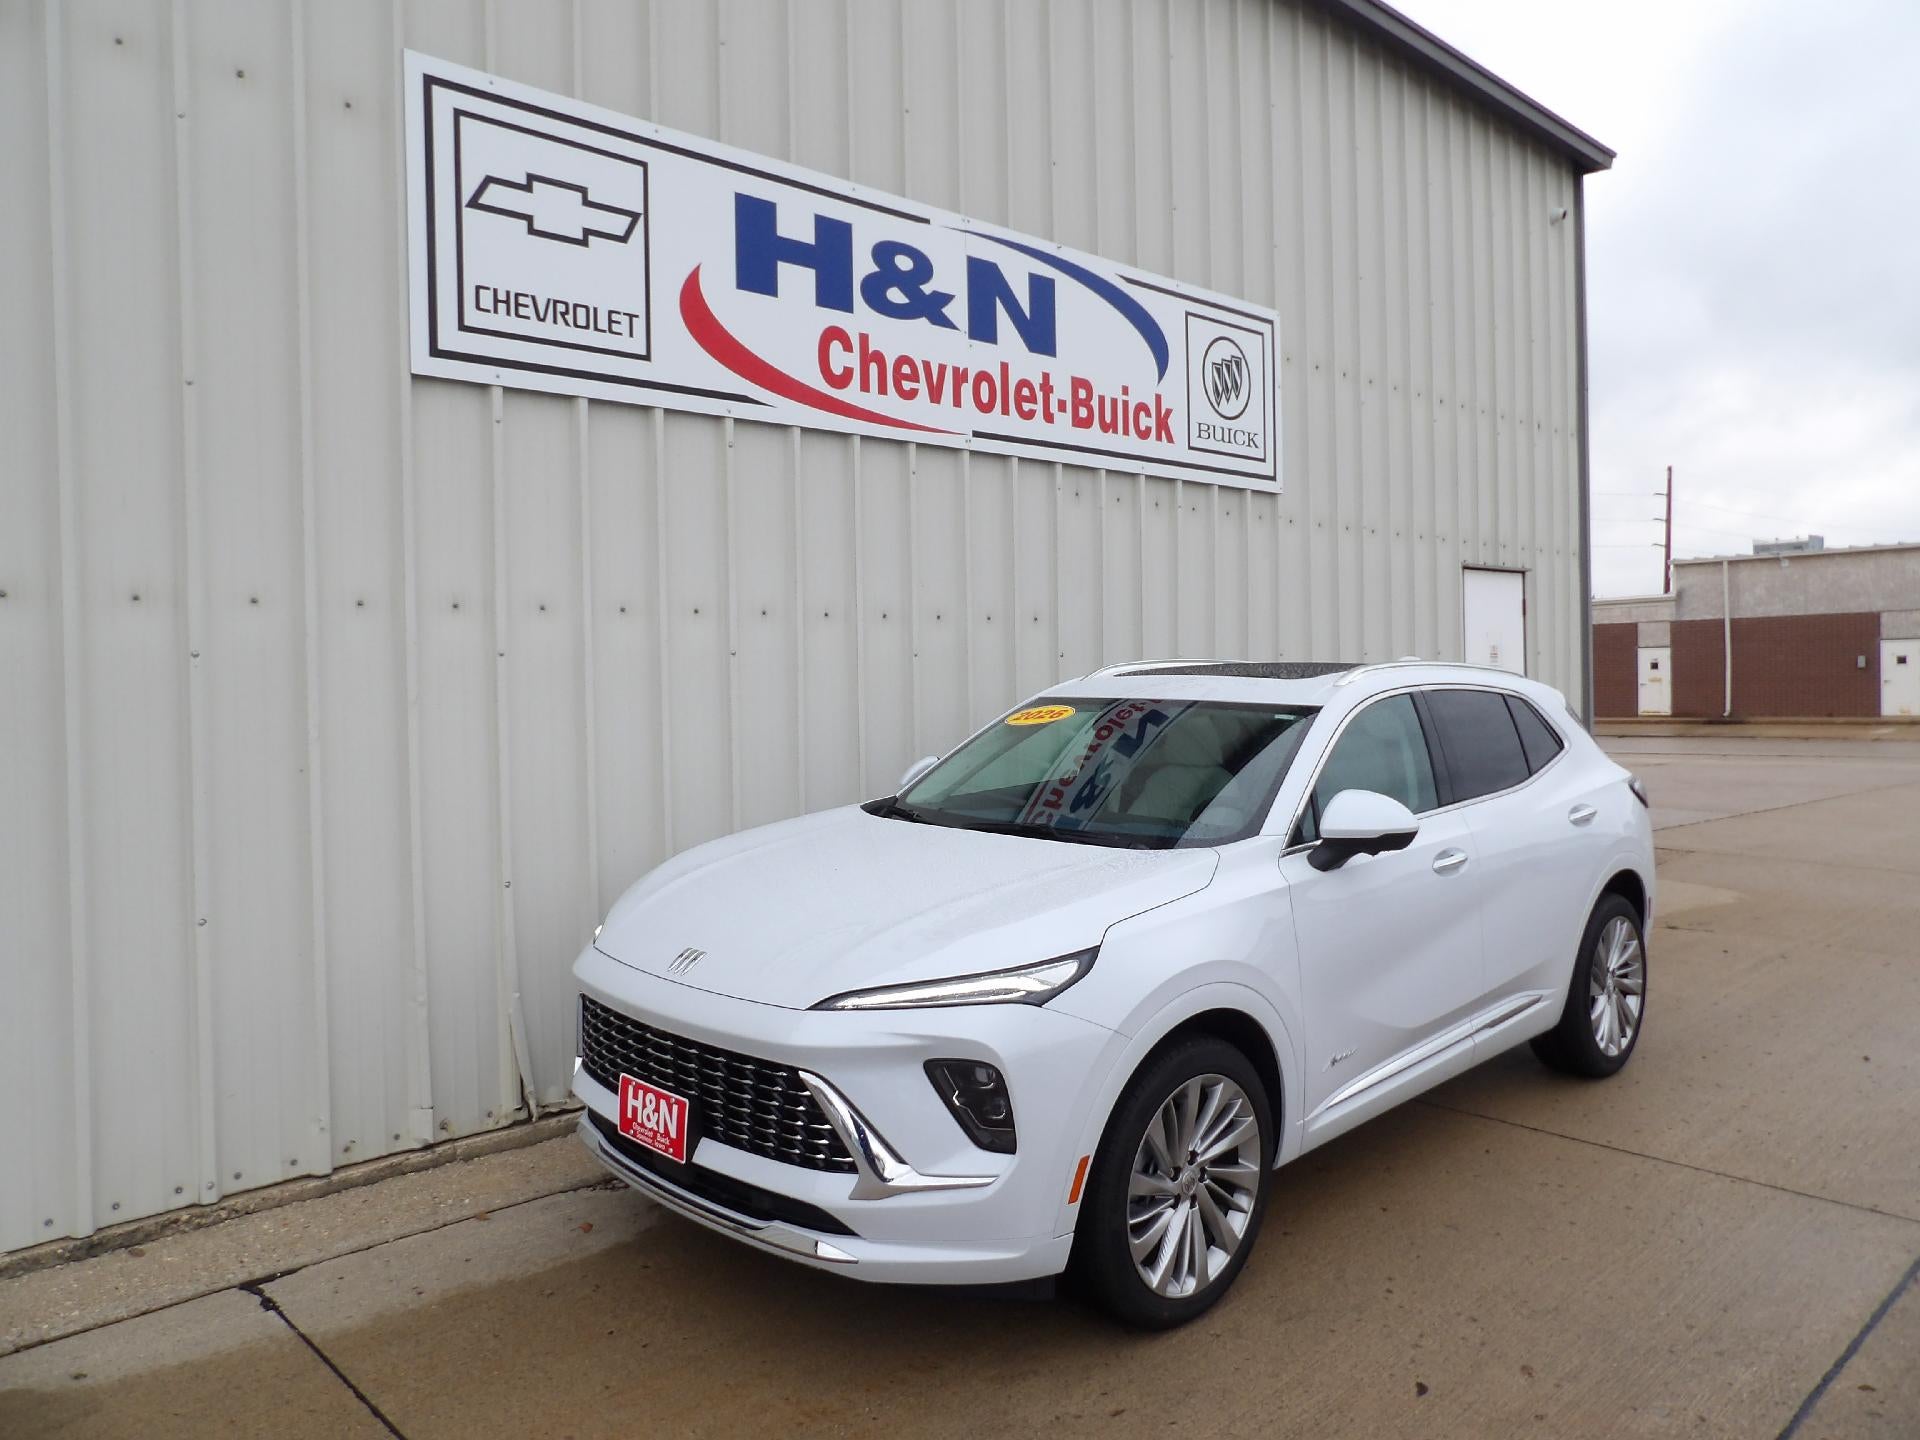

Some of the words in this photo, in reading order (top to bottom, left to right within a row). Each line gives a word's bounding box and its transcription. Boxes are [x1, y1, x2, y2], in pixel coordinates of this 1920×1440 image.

[735, 191, 1057, 358] H&N
[474, 284, 640, 339] CHEVROLET
[1195, 421, 1260, 449] BUICK
[1008, 709, 1070, 721] 2026
[627, 1084, 679, 1139] H&N
[656, 1132, 670, 1146] Buick
